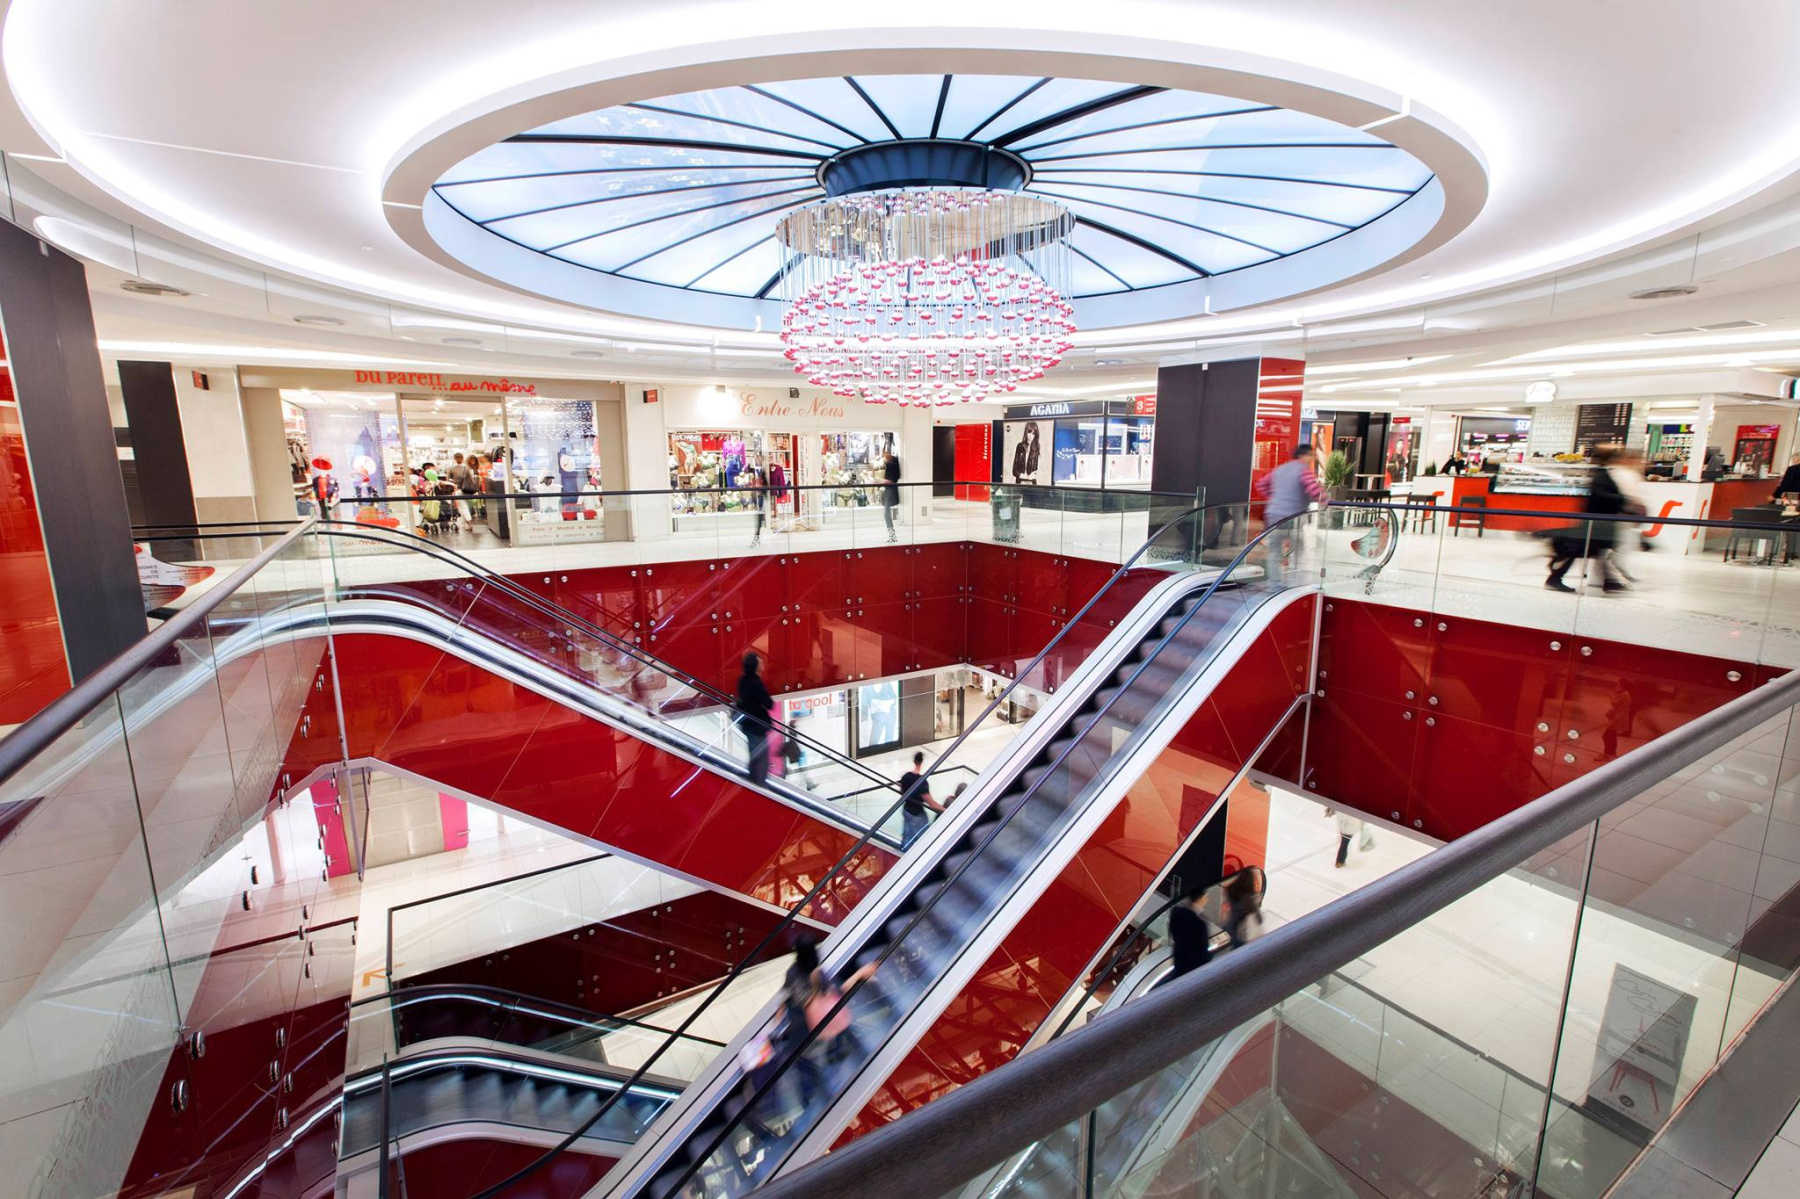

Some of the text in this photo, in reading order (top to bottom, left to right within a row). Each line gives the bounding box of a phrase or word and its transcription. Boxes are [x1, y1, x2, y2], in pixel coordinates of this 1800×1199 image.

[480, 379, 537, 396] même
[740, 391, 791, 417] Entre
[1030, 403, 1070, 416] AGATHA
